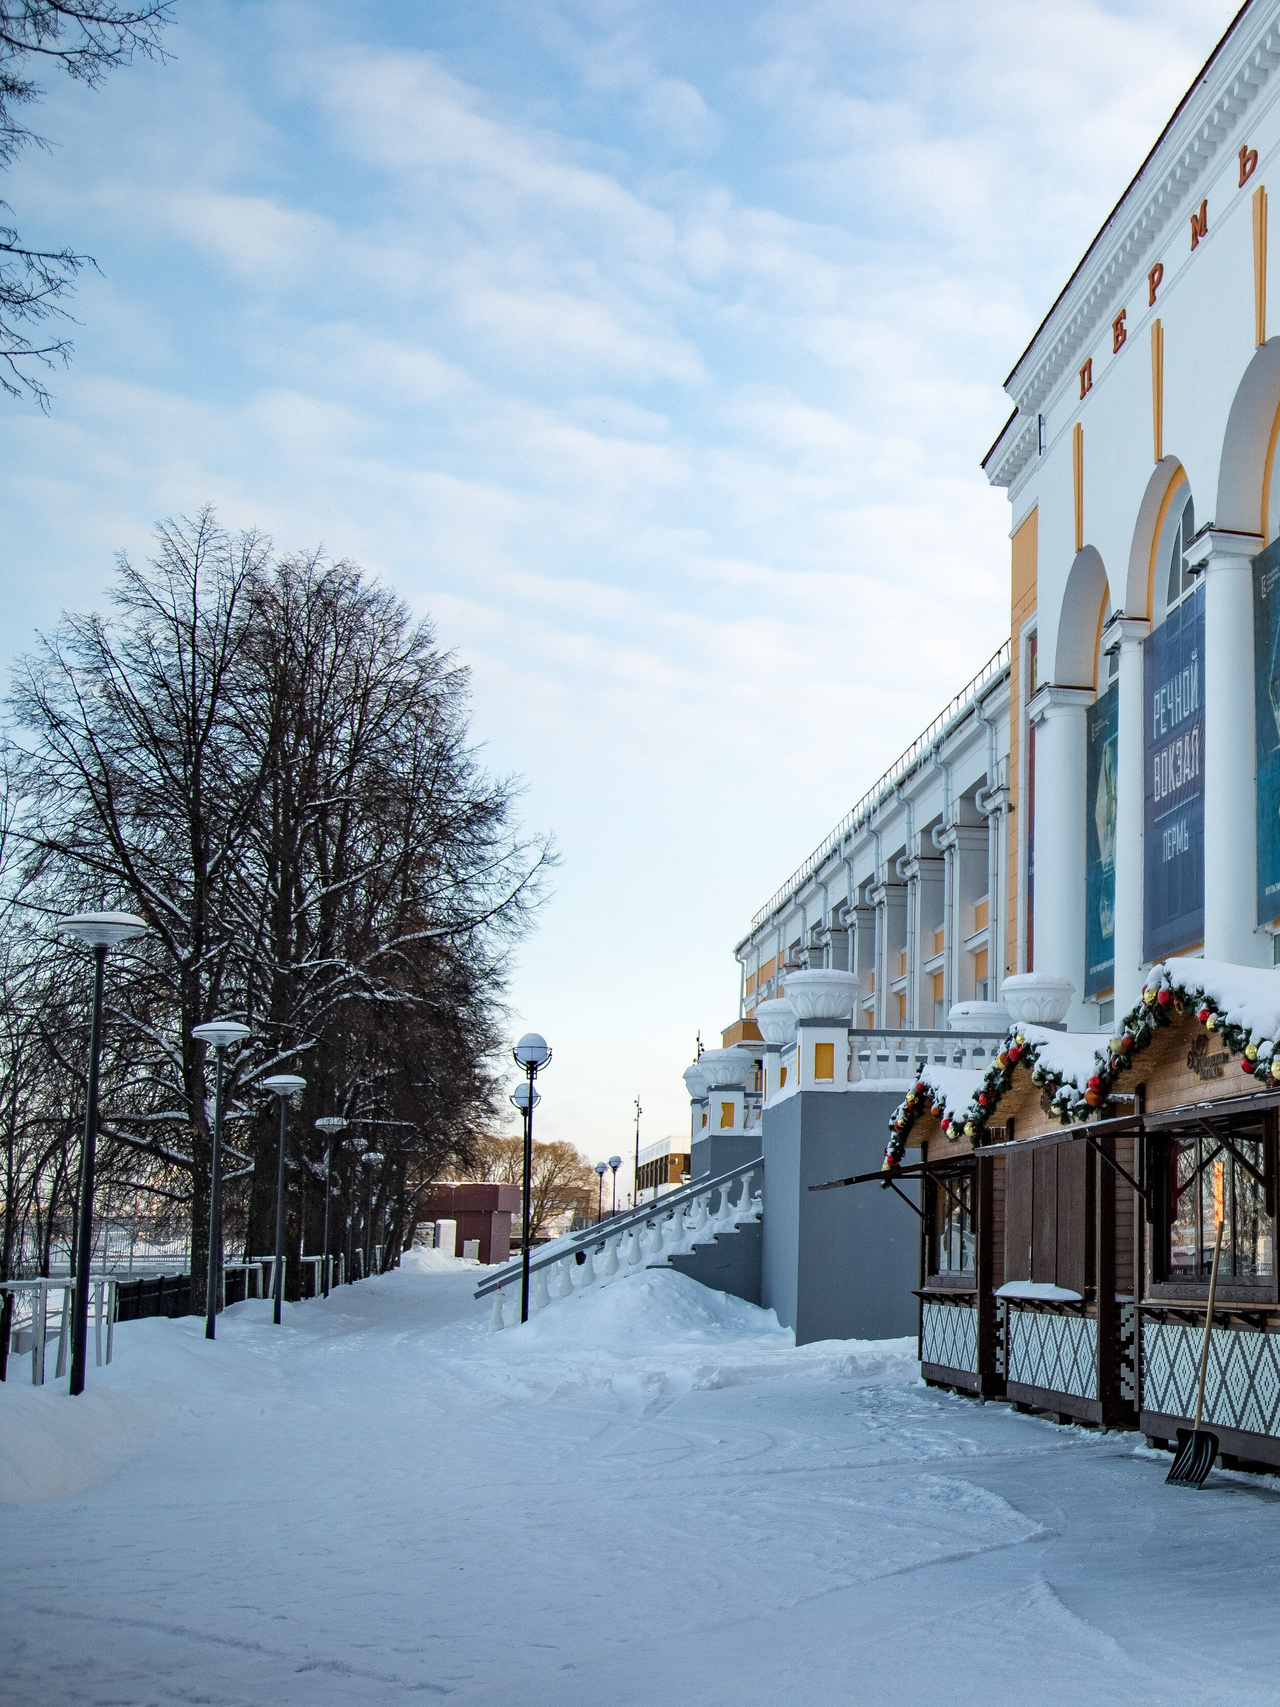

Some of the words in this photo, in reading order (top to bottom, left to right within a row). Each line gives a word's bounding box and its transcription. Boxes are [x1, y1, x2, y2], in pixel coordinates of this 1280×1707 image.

[1079, 145, 1259, 400] ПЕРМЬ
[1153, 647, 1199, 739] РЕЧНОЙ
[1154, 724, 1200, 802] ВОКЗАЛ
[1163, 818, 1189, 863] ПЕРМЬ
